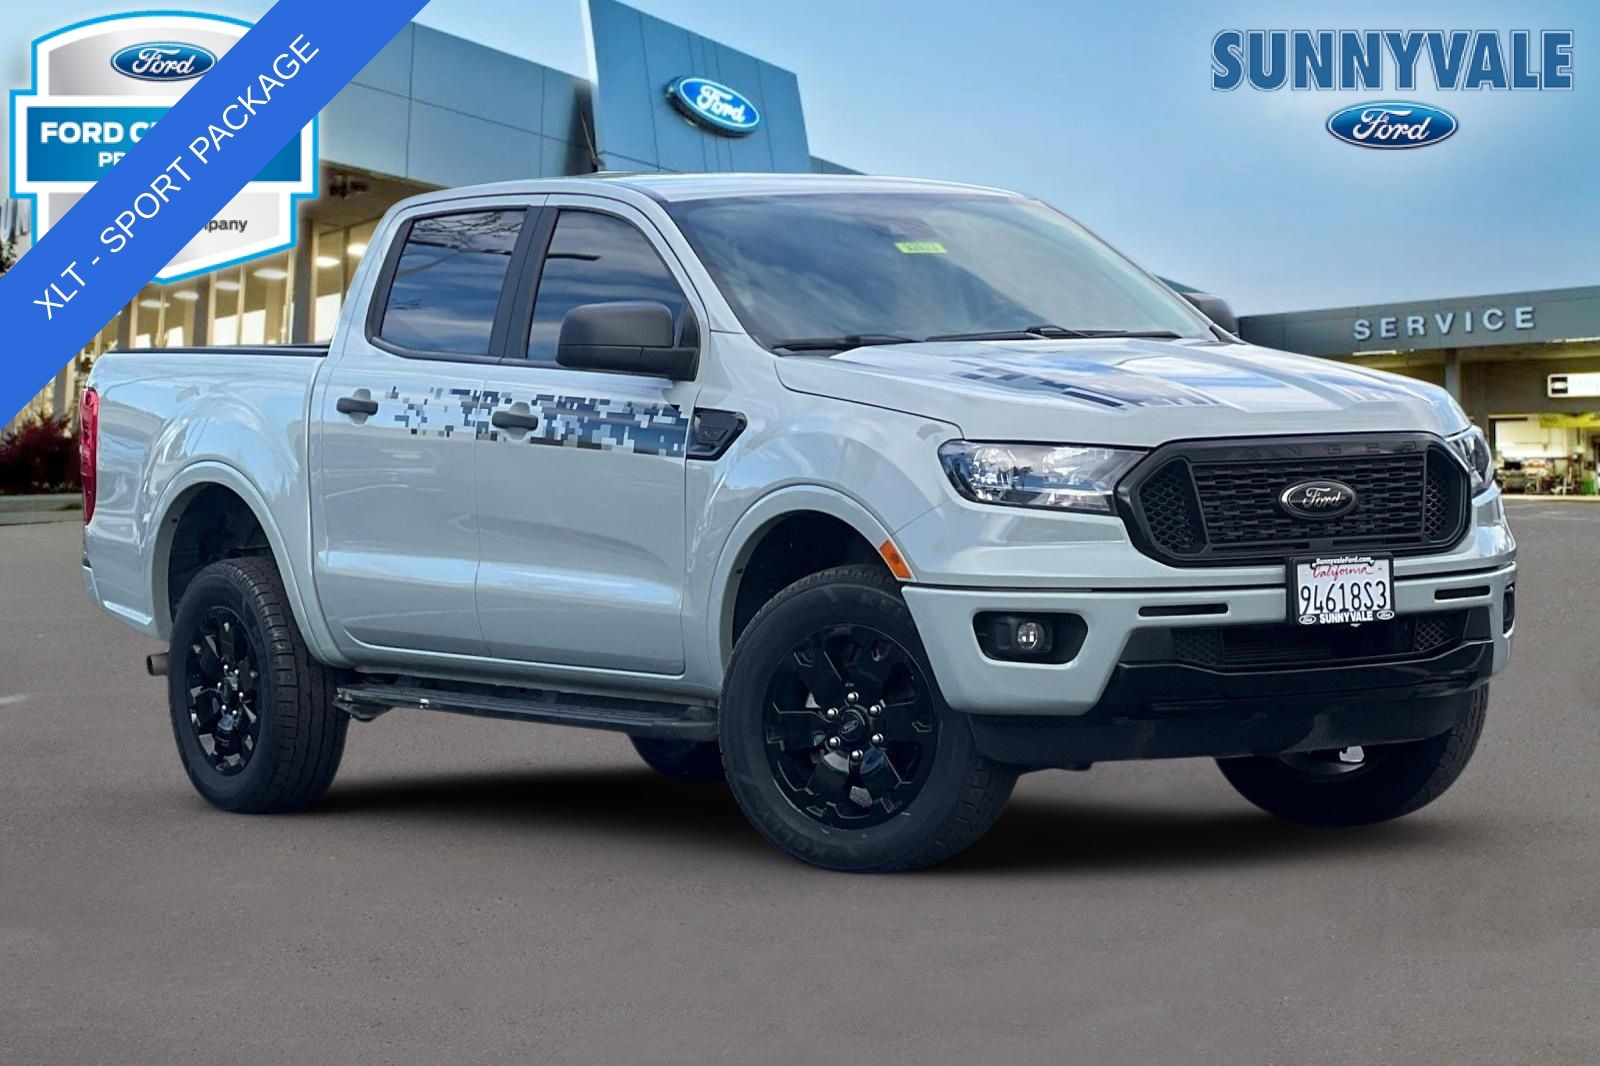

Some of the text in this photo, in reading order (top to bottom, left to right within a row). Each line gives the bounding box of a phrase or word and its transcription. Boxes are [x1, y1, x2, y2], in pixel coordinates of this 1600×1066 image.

[696, 84, 745, 123] Ford
[1354, 307, 1535, 340] SERVICE
[1303, 487, 1342, 508] Ford
[1316, 556, 1372, 566] SunnyvaleFord.com
[1312, 564, 1373, 581] California
[1300, 580, 1387, 616] 94618S3
[1320, 611, 1373, 624] SUNNYVALE
